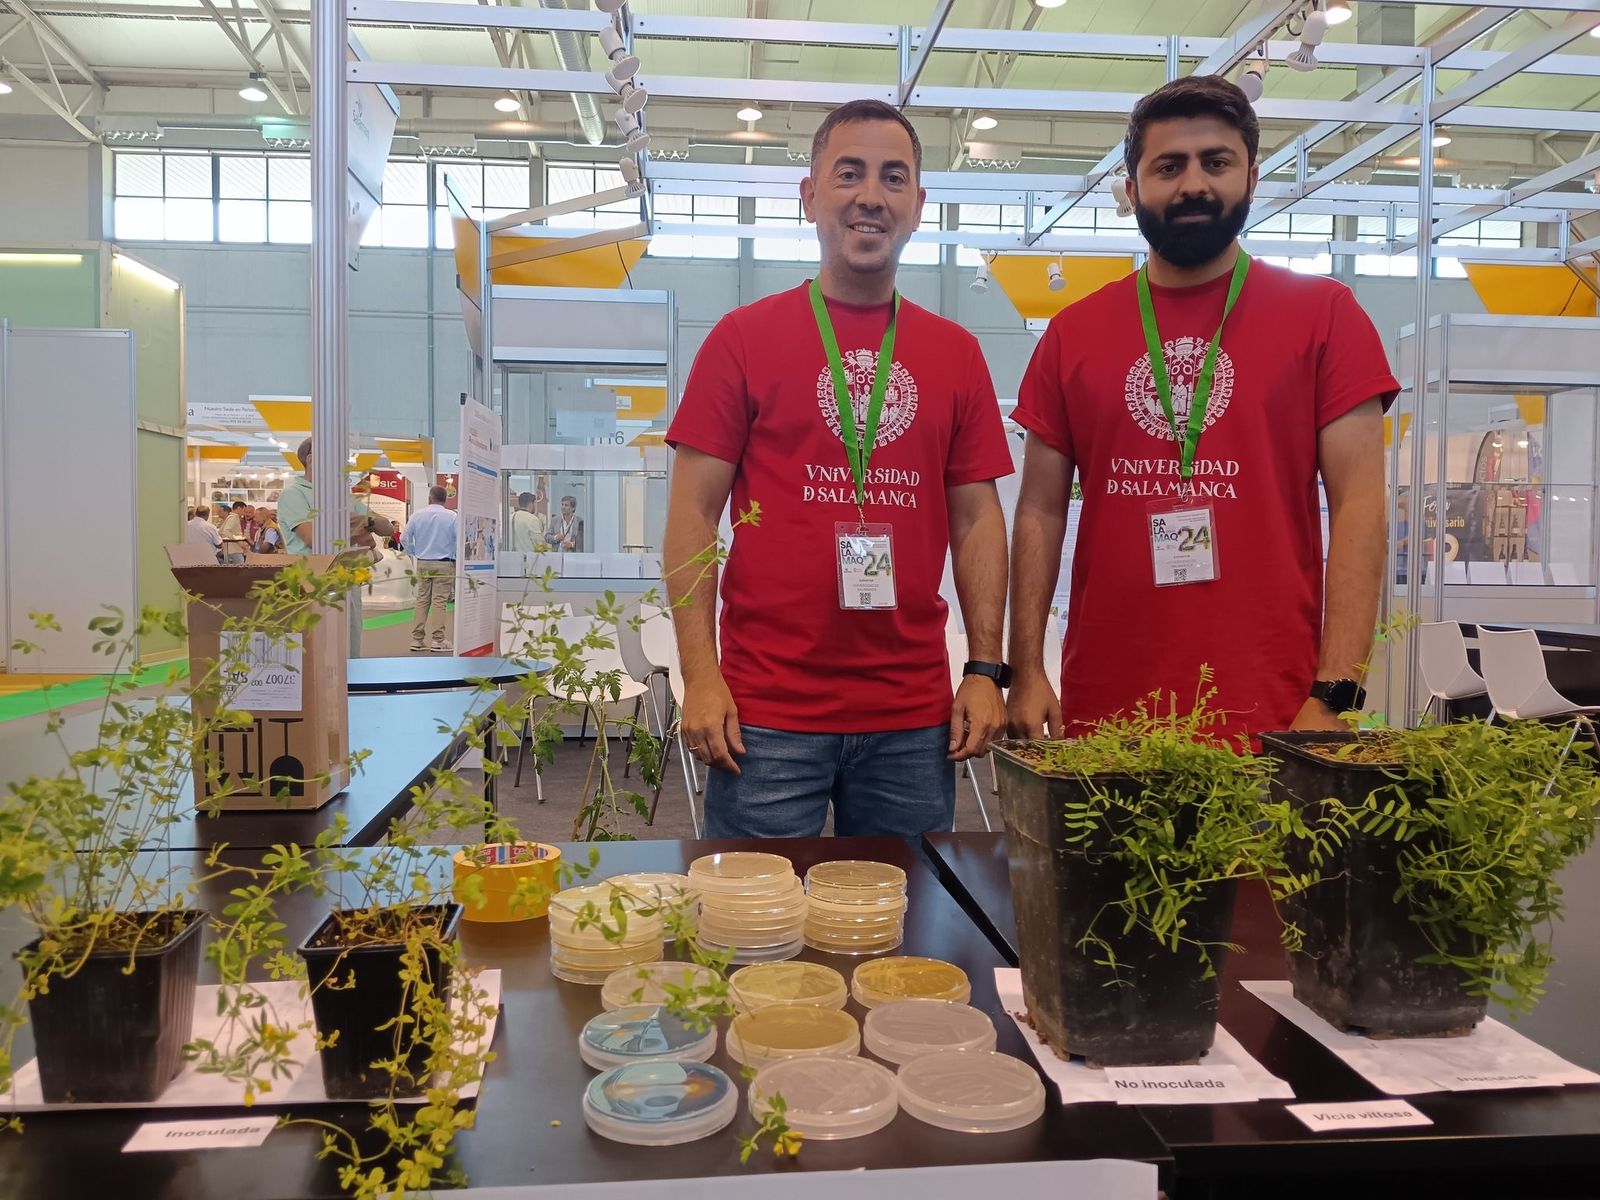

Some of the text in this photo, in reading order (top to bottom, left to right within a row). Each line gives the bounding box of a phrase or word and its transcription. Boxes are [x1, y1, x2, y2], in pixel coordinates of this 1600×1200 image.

[805, 464, 920, 486] VNiVRSiDAD
[379, 480, 398, 488] SIC
[1121, 480, 1238, 499] SALAMANCA
[818, 487, 917, 508] SALAMANCA
[1153, 518, 1166, 527] SA
[1153, 526, 1165, 535] LA
[1154, 532, 1178, 543] MAQ
[840, 540, 853, 549] SA
[841, 549, 852, 557] LA
[842, 556, 864, 565] MAQ
[265, 674, 296, 685] 37007
[1114, 1078, 1226, 1090] No inoculada
[1312, 1108, 1414, 1122] Vicia villosa
[164, 1126, 261, 1139] Inoculada
